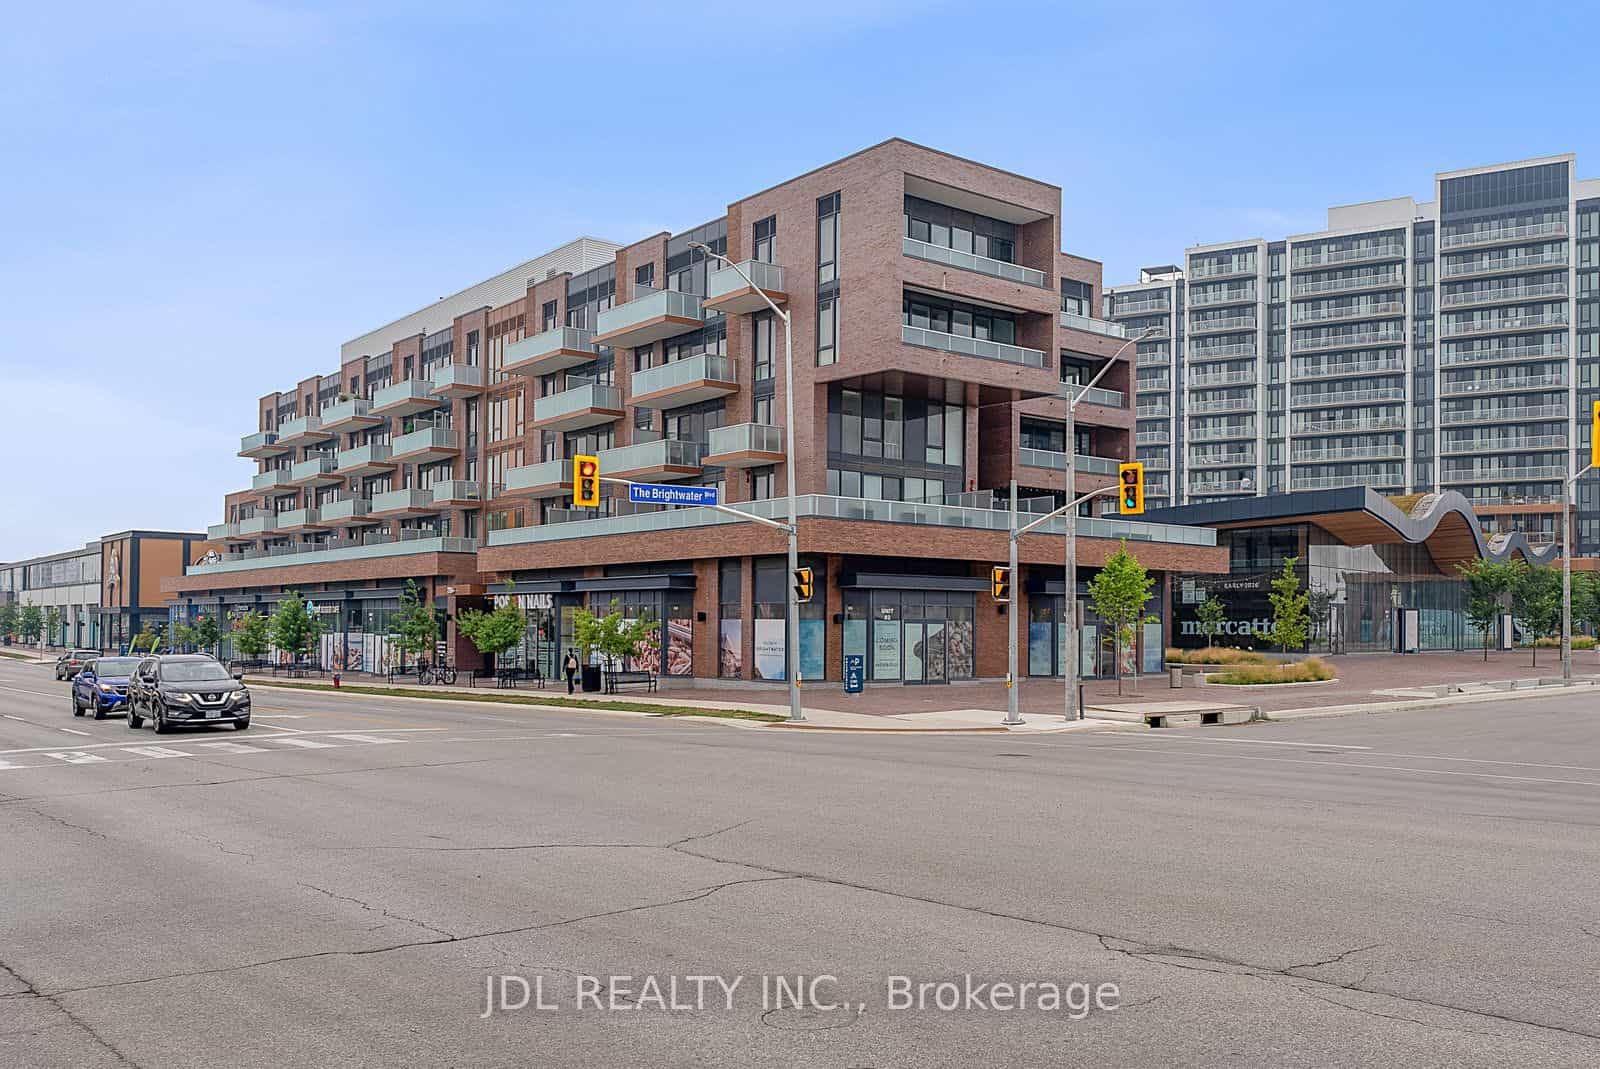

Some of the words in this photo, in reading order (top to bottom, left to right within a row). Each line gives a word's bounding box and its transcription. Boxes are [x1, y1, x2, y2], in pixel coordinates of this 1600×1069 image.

[633, 487, 650, 498] The
[652, 488, 702, 501] Brightwater
[526, 593, 553, 609] NAILS
